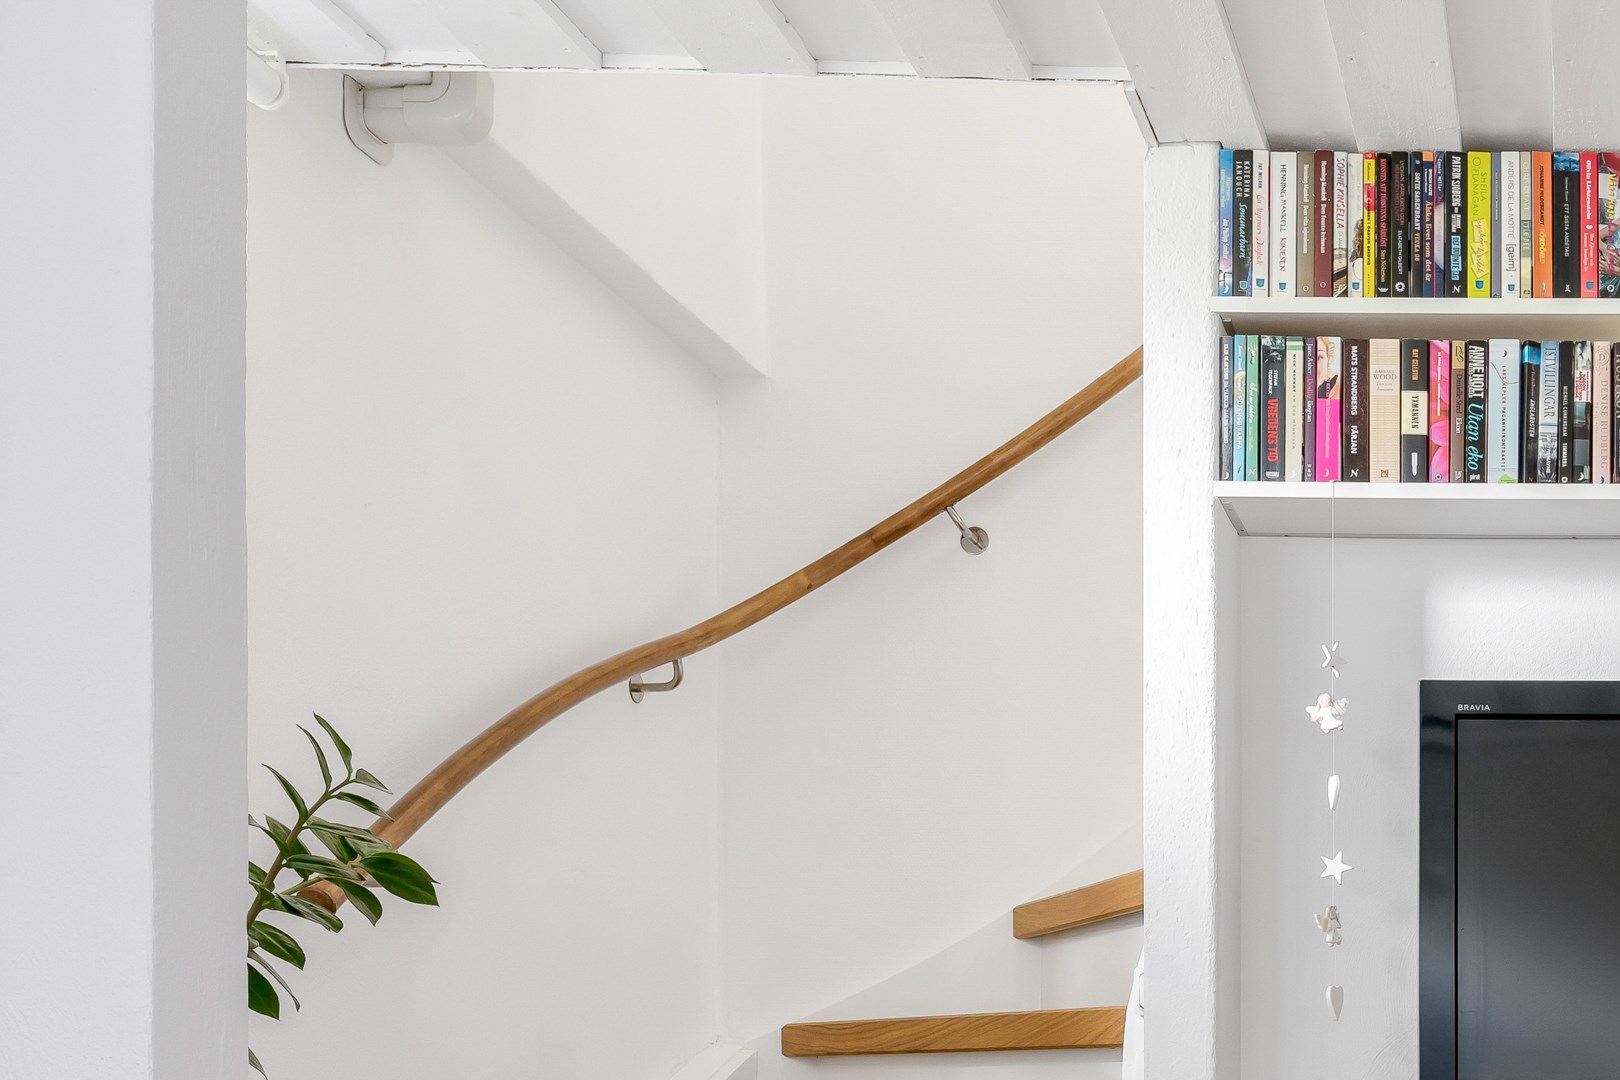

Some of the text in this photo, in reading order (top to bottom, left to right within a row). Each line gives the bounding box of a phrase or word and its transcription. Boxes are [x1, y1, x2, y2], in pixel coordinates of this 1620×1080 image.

[1235, 160, 1243, 198] JANOUCH
[1243, 160, 1251, 198] KATERINA
[1335, 157, 1346, 188] SOPHIE
[1507, 160, 1515, 189] ANDERS
[1335, 188, 1346, 230] KINSELLA
[1424, 200, 1433, 223] Älska
[1507, 190, 1515, 202] DE
[1507, 204, 1515, 215] LA
[1239, 202, 1249, 260] Sommarbarn
[1279, 164, 1287, 273] HENNING MANKELL KINESEN
[1424, 223, 1433, 241] livet
[1507, 215, 1515, 239] MOTTE
[1424, 241, 1433, 257] som
[1424, 257, 1433, 272] det
[1471, 346, 1485, 400] ANNE HOLT
[1543, 347, 1557, 419] ISTVILLINGAR
[1350, 345, 1360, 455] MATS STRANDBERG FÄRJAN
[1410, 395, 1419, 430] YXMANNEN
[1267, 399, 1279, 463] VREDENS TID
[1467, 403, 1484, 471] Utan eko
[1457, 703, 1491, 712] BRAVIA
